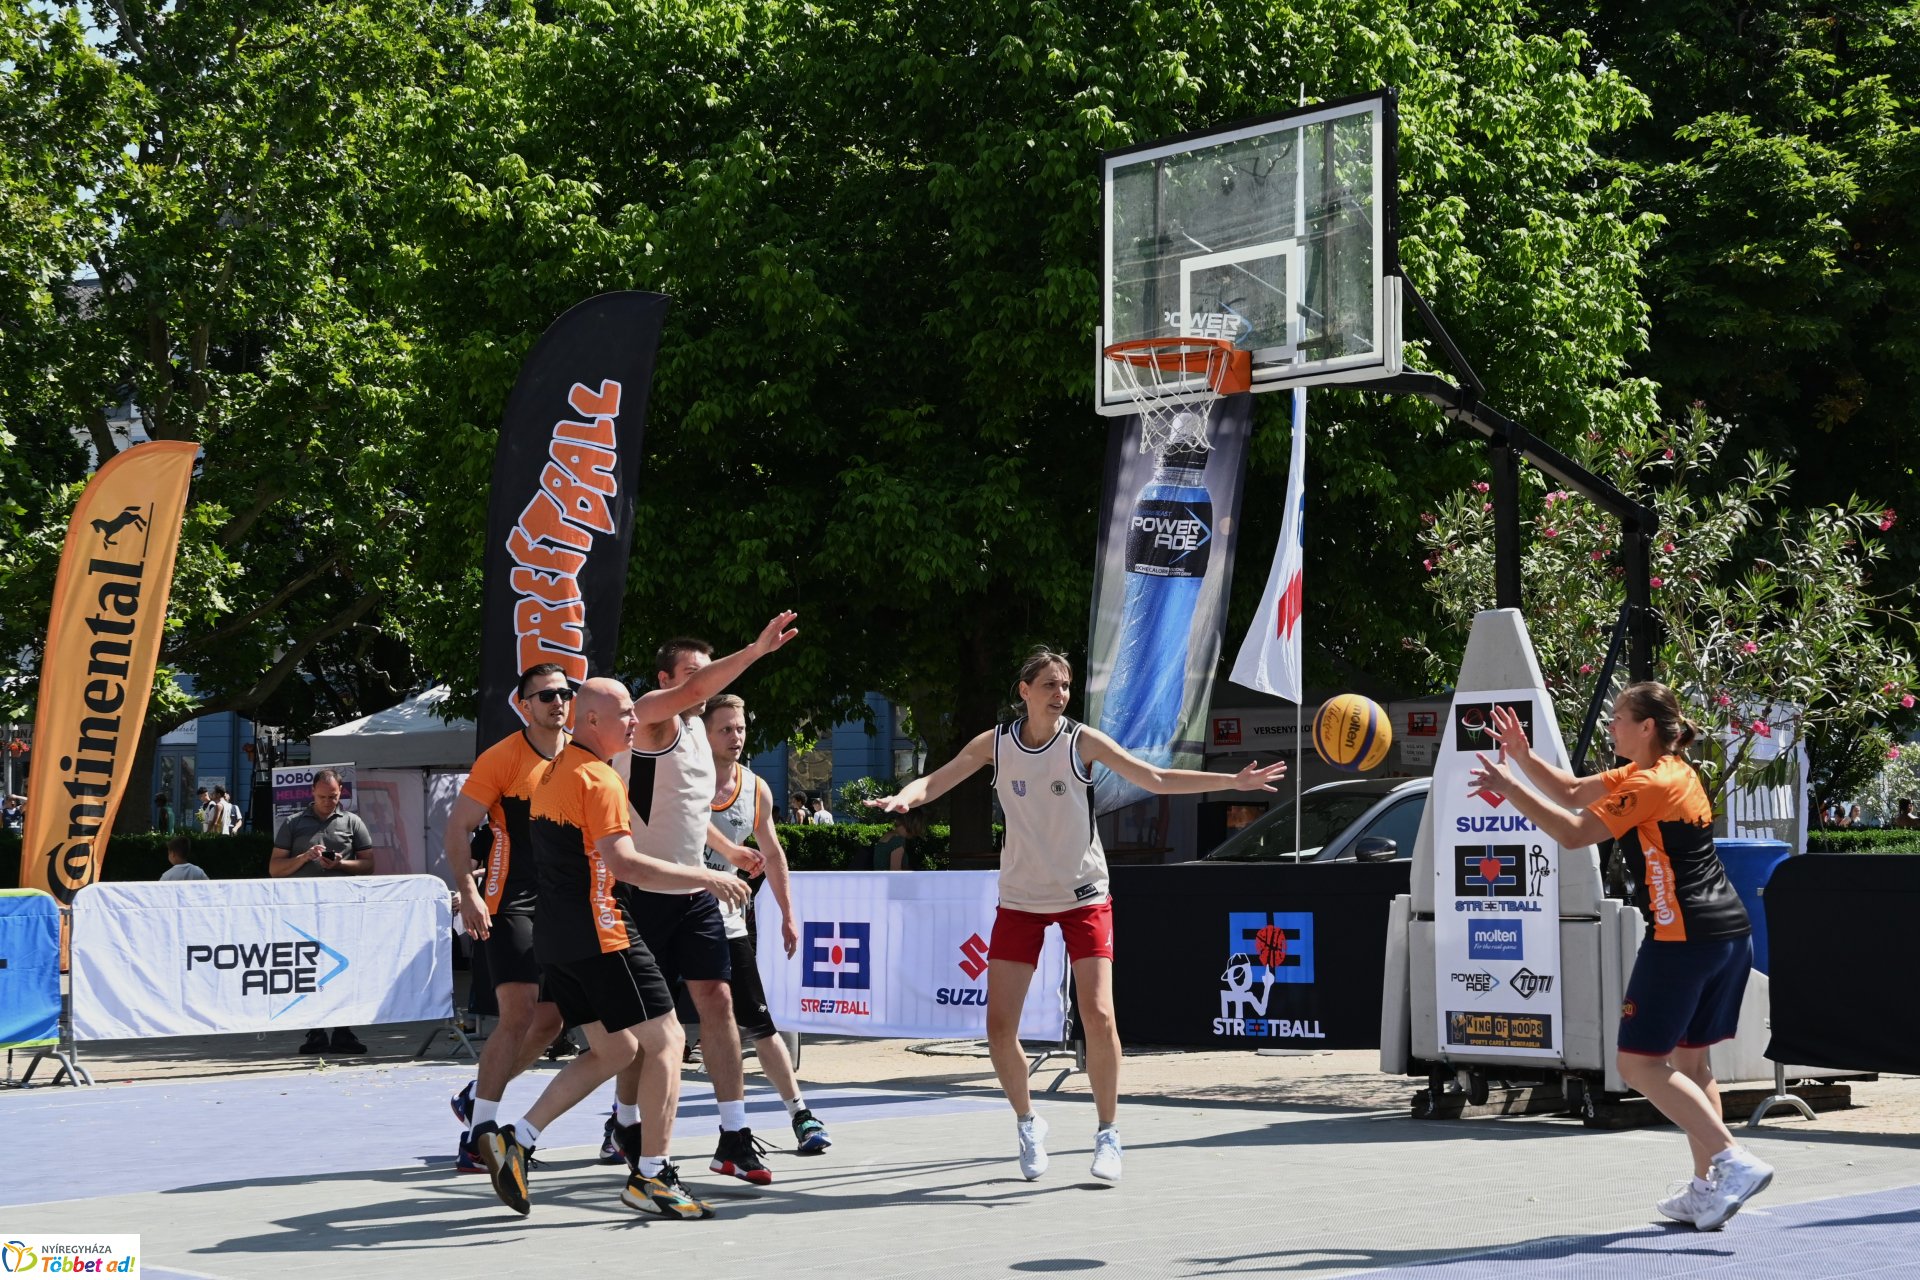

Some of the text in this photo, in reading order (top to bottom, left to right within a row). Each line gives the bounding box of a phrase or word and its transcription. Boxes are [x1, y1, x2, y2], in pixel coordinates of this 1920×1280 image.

[1131, 517, 1201, 535] POWER
[1154, 533, 1198, 551] ADE
[47, 558, 144, 905] Continental
[1345, 704, 1361, 750] molten
[1474, 929, 1517, 942] molten
[187, 941, 320, 971] POWER
[242, 967, 317, 996] ADE
[1451, 973, 1491, 982] POWER
[1466, 982, 1490, 991] ADE
[1519, 975, 1554, 993] TOTI
[936, 988, 988, 1006] SUZU
[1467, 1015, 1542, 1034] KING OF HOOPS
